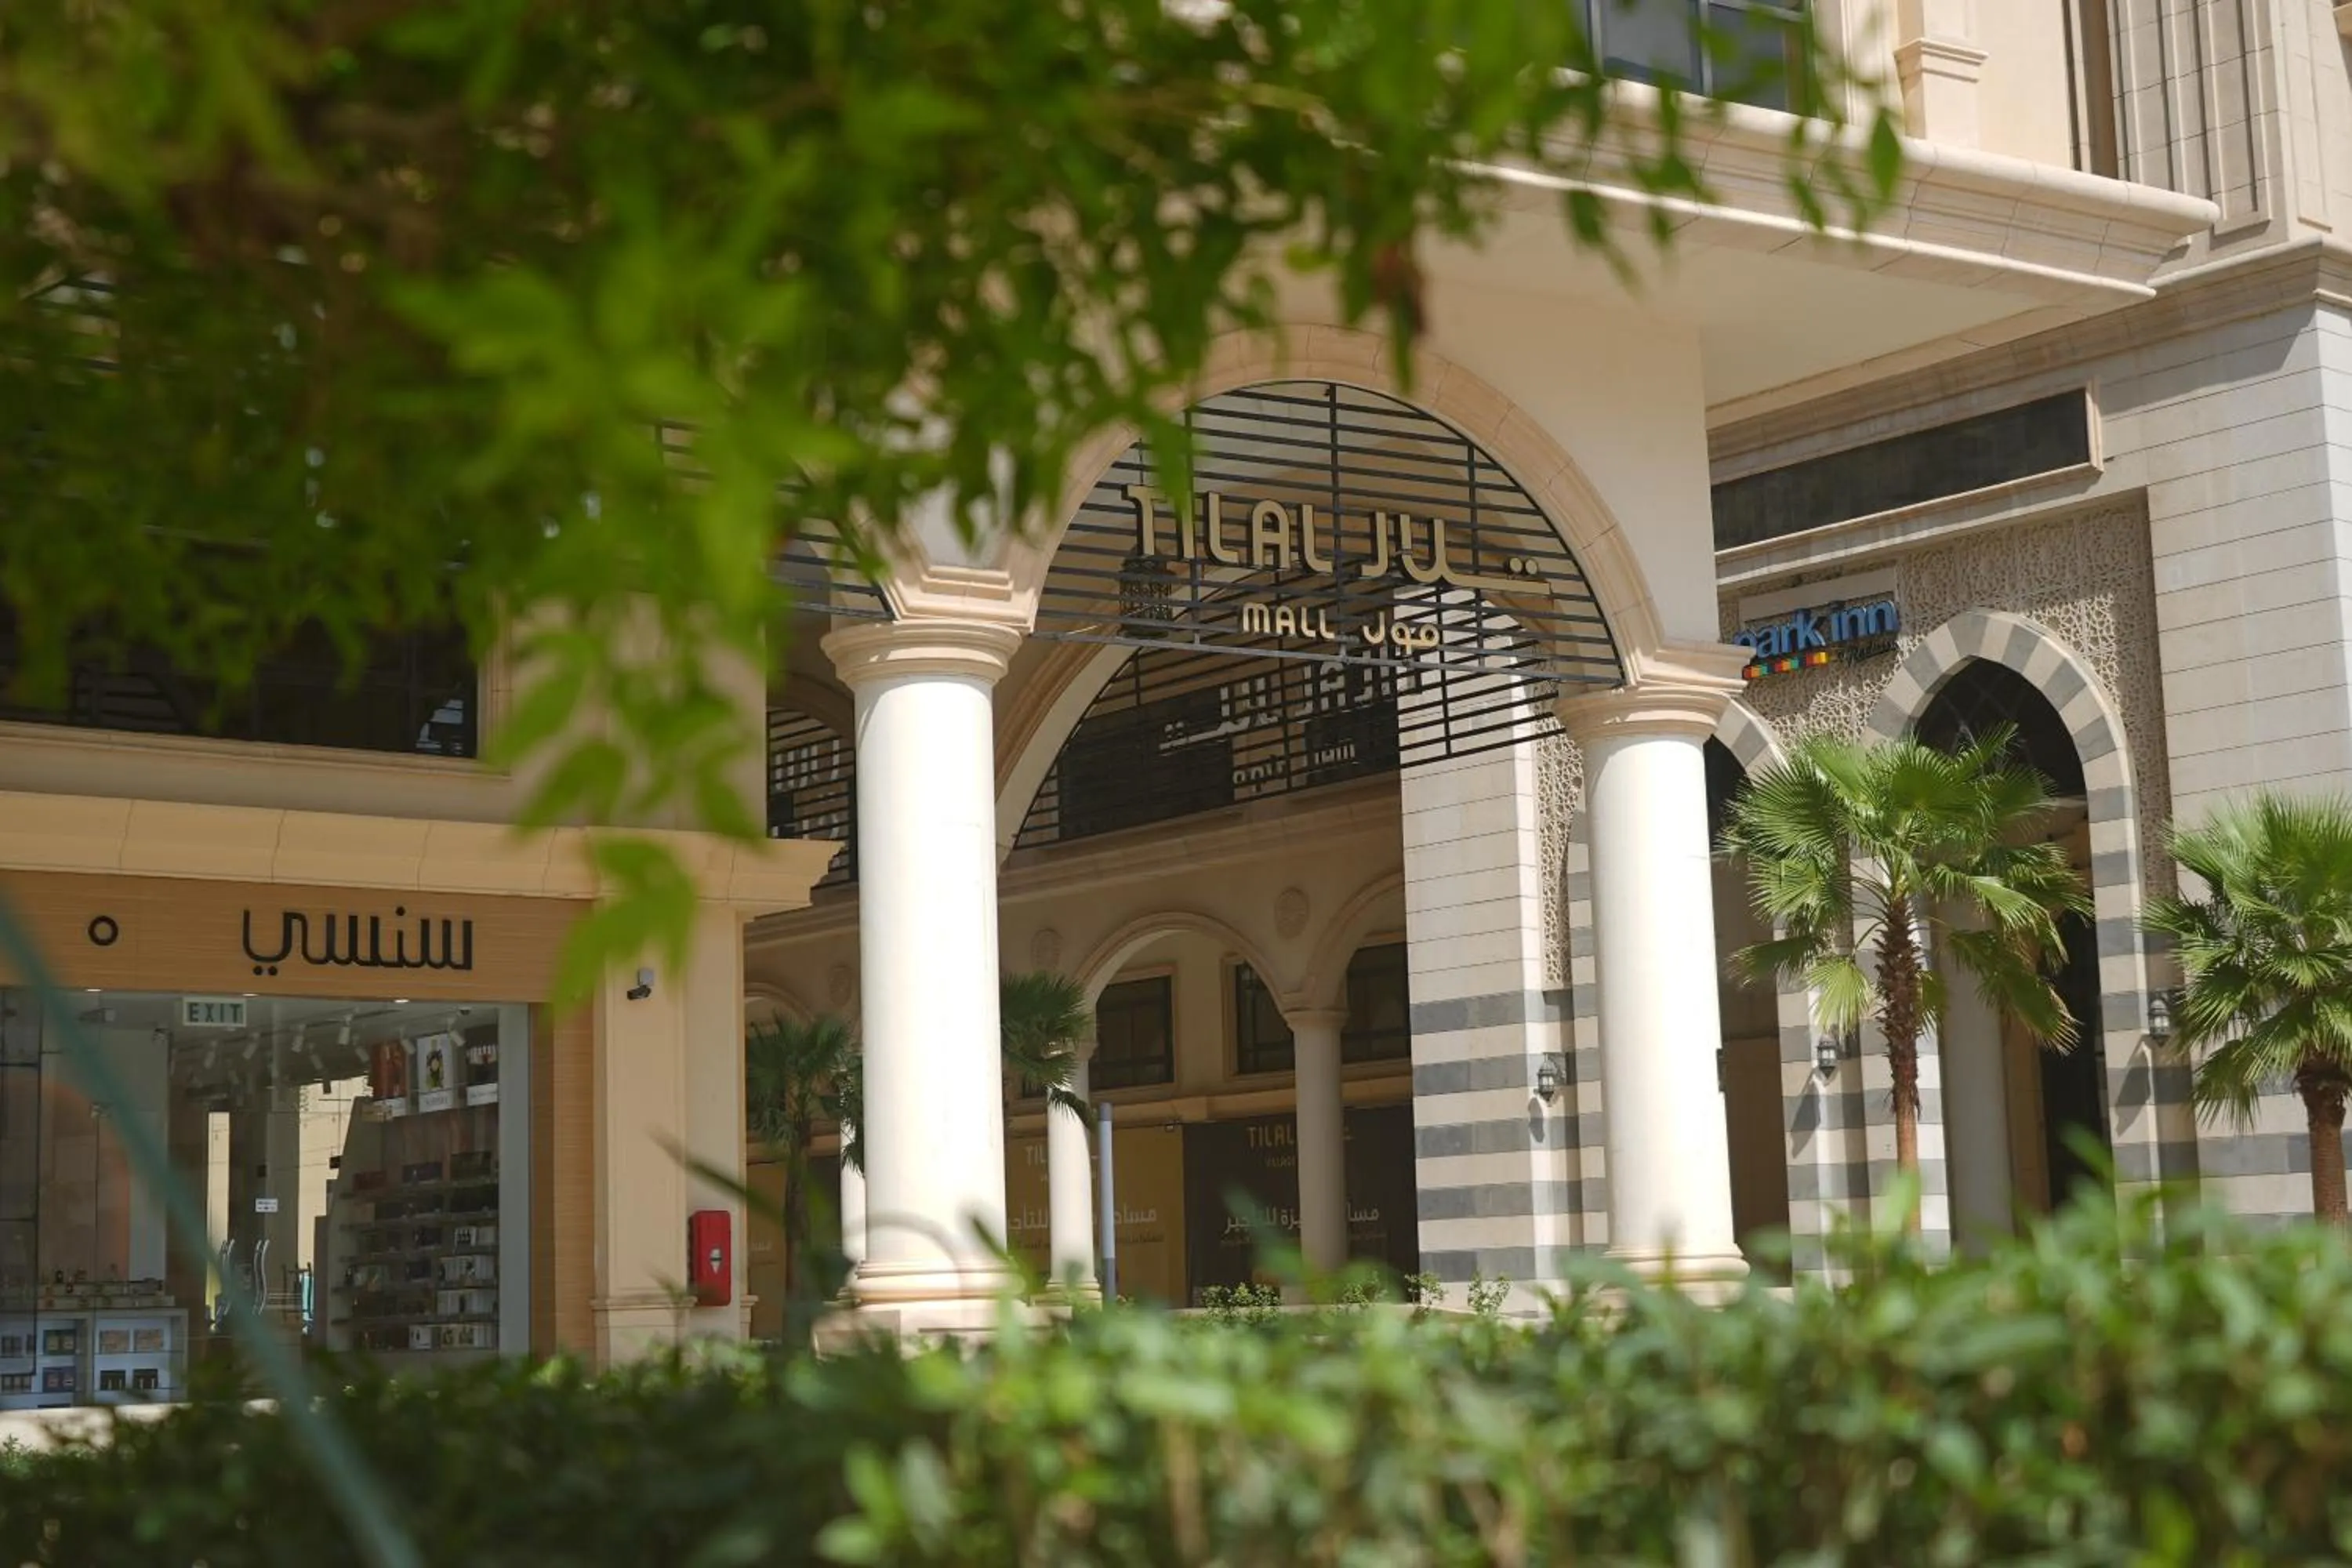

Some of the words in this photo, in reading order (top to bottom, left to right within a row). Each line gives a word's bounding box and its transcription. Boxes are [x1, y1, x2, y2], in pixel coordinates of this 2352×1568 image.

[1122, 483, 1334, 574] TILAL
[1242, 601, 1336, 640] MALL
[1362, 610, 1441, 655] مول
[1829, 600, 1900, 642] inn
[189, 1002, 243, 1024] EXIT
